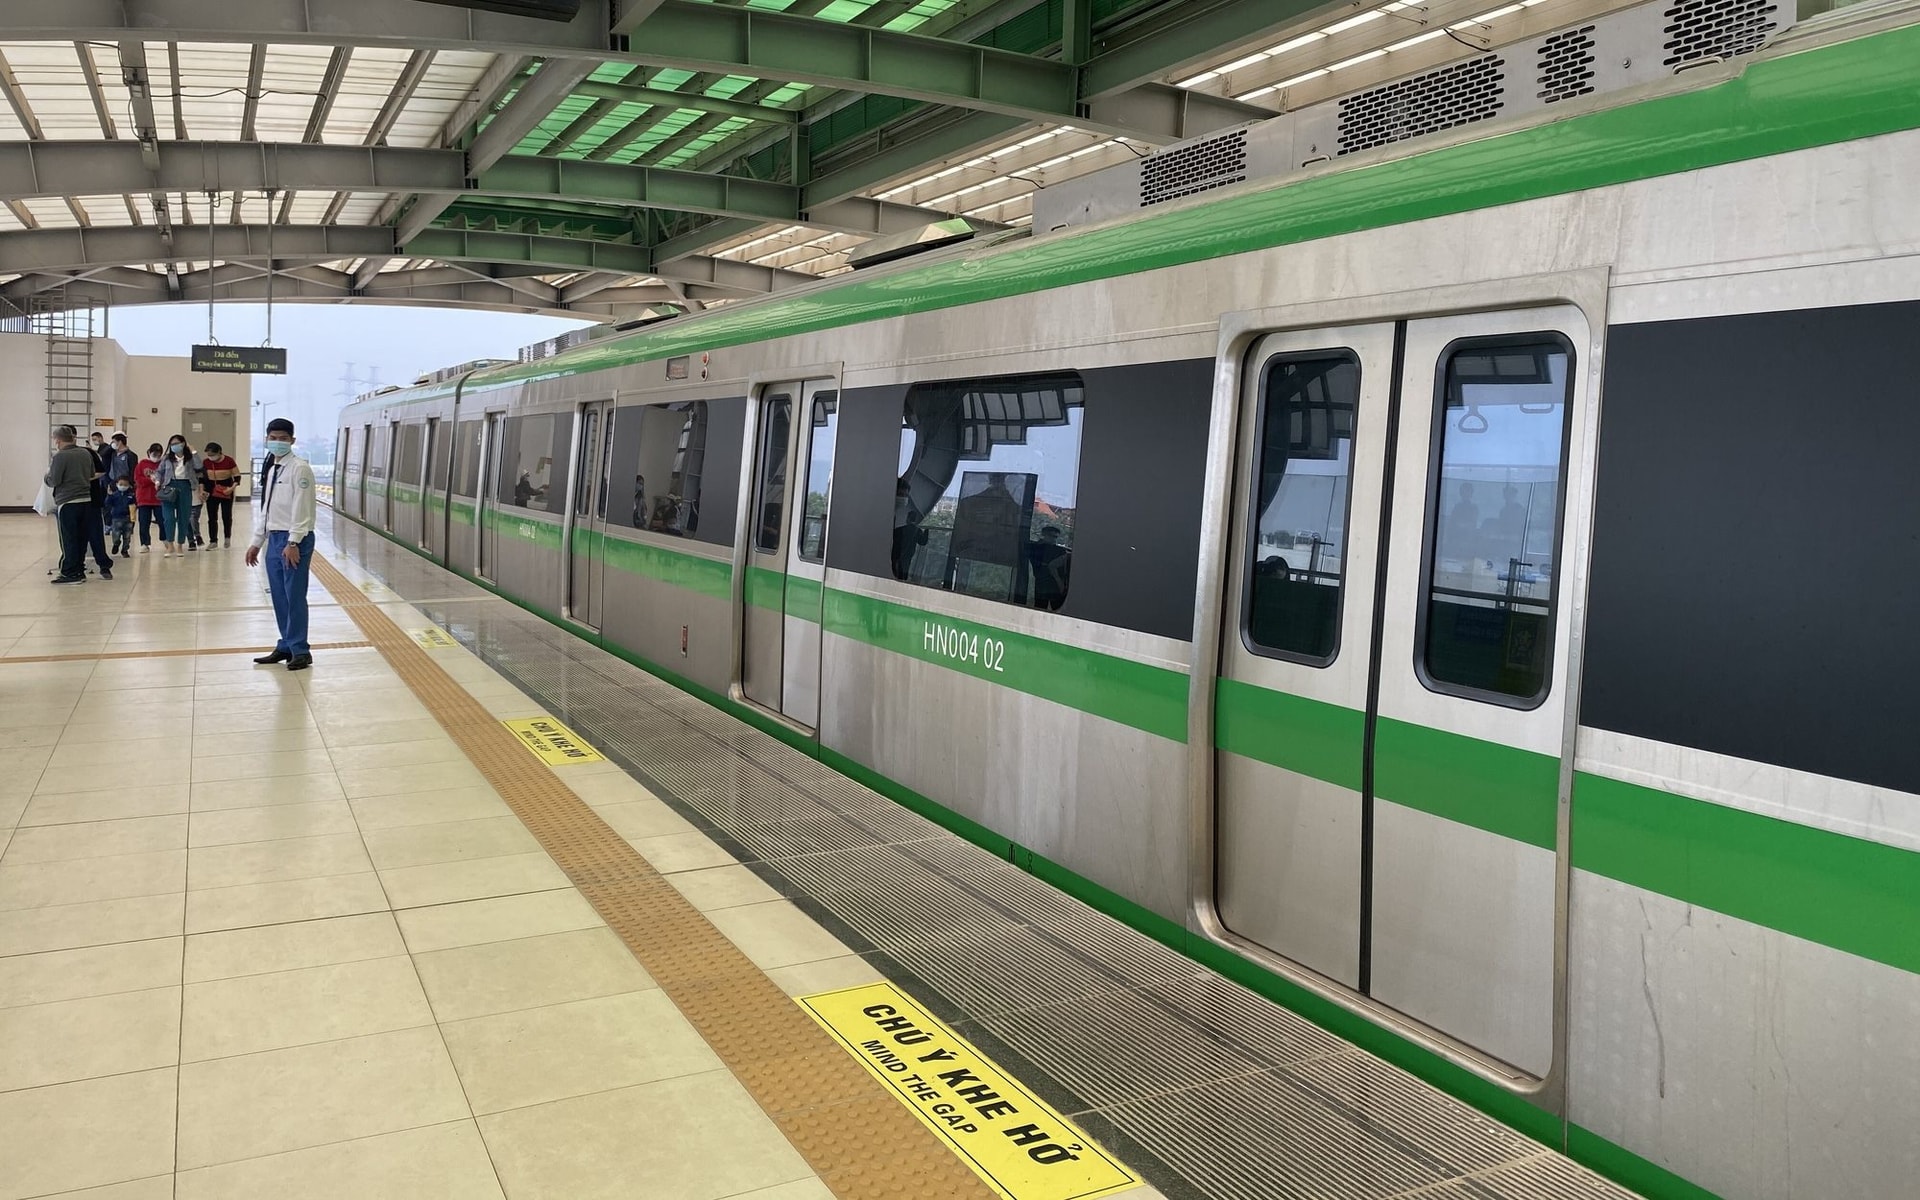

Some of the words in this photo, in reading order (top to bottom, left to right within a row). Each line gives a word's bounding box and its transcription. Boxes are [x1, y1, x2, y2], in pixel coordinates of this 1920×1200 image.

[923, 621, 979, 665] HN004
[983, 637, 1005, 673] 02
[548, 736, 575, 749] KHE
[862, 1004, 934, 1046] CHÚ
[917, 1048, 959, 1063] Ý
[860, 1040, 908, 1073] MIND
[901, 1074, 941, 1102] THE
[932, 1103, 978, 1134] GAP
[937, 1068, 1020, 1120] KHE
[1002, 1123, 1084, 1165] HỞ
